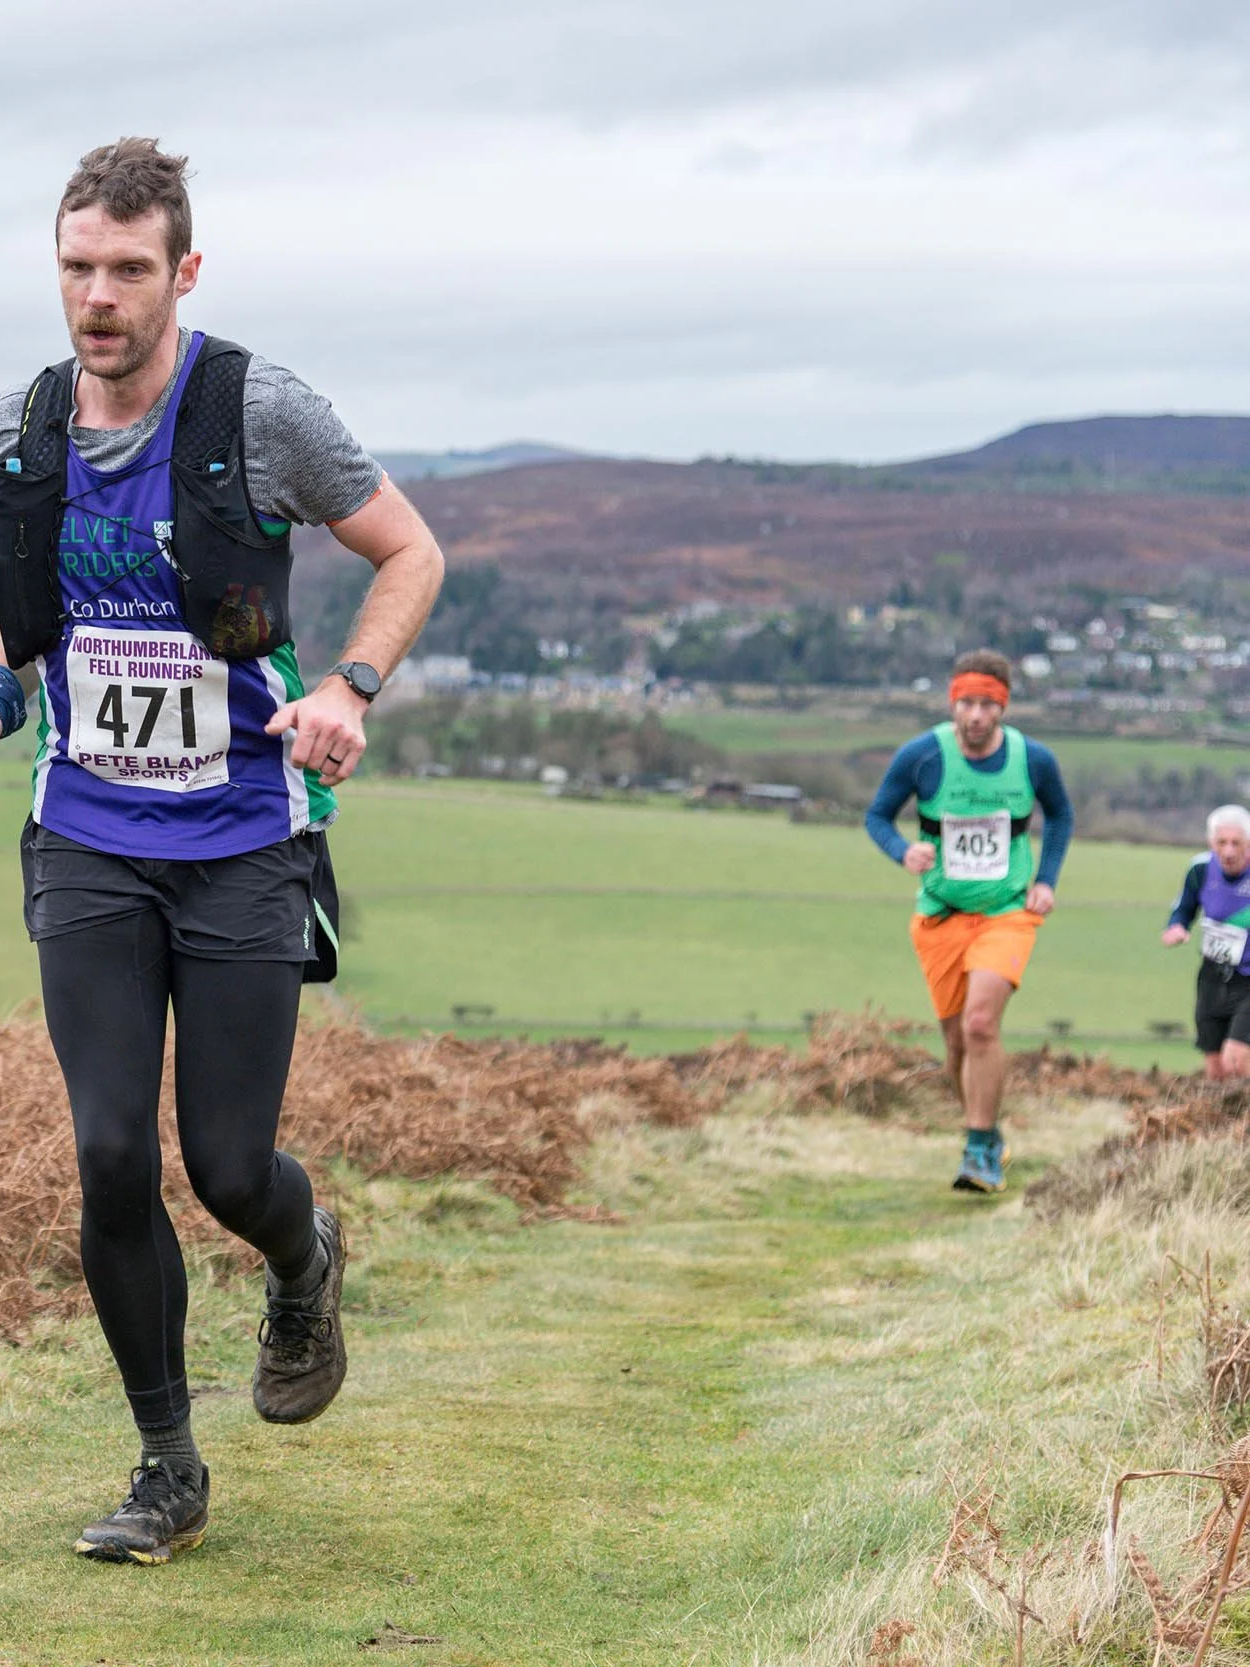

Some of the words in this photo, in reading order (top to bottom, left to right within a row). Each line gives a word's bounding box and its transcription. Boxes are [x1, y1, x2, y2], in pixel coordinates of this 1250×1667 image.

[60, 517, 134, 543] ELVET
[57, 552, 158, 576] RIDERS
[70, 599, 94, 618] Co
[72, 635, 218, 661] NORTHUMBERLAN
[89, 658, 123, 677] FELL
[128, 661, 203, 680] RUNNERS
[96, 684, 197, 748] 471
[78, 752, 139, 768] PETE
[146, 751, 224, 771] BLAND
[118, 768, 189, 782] SPORTS
[955, 832, 999, 857] 405
